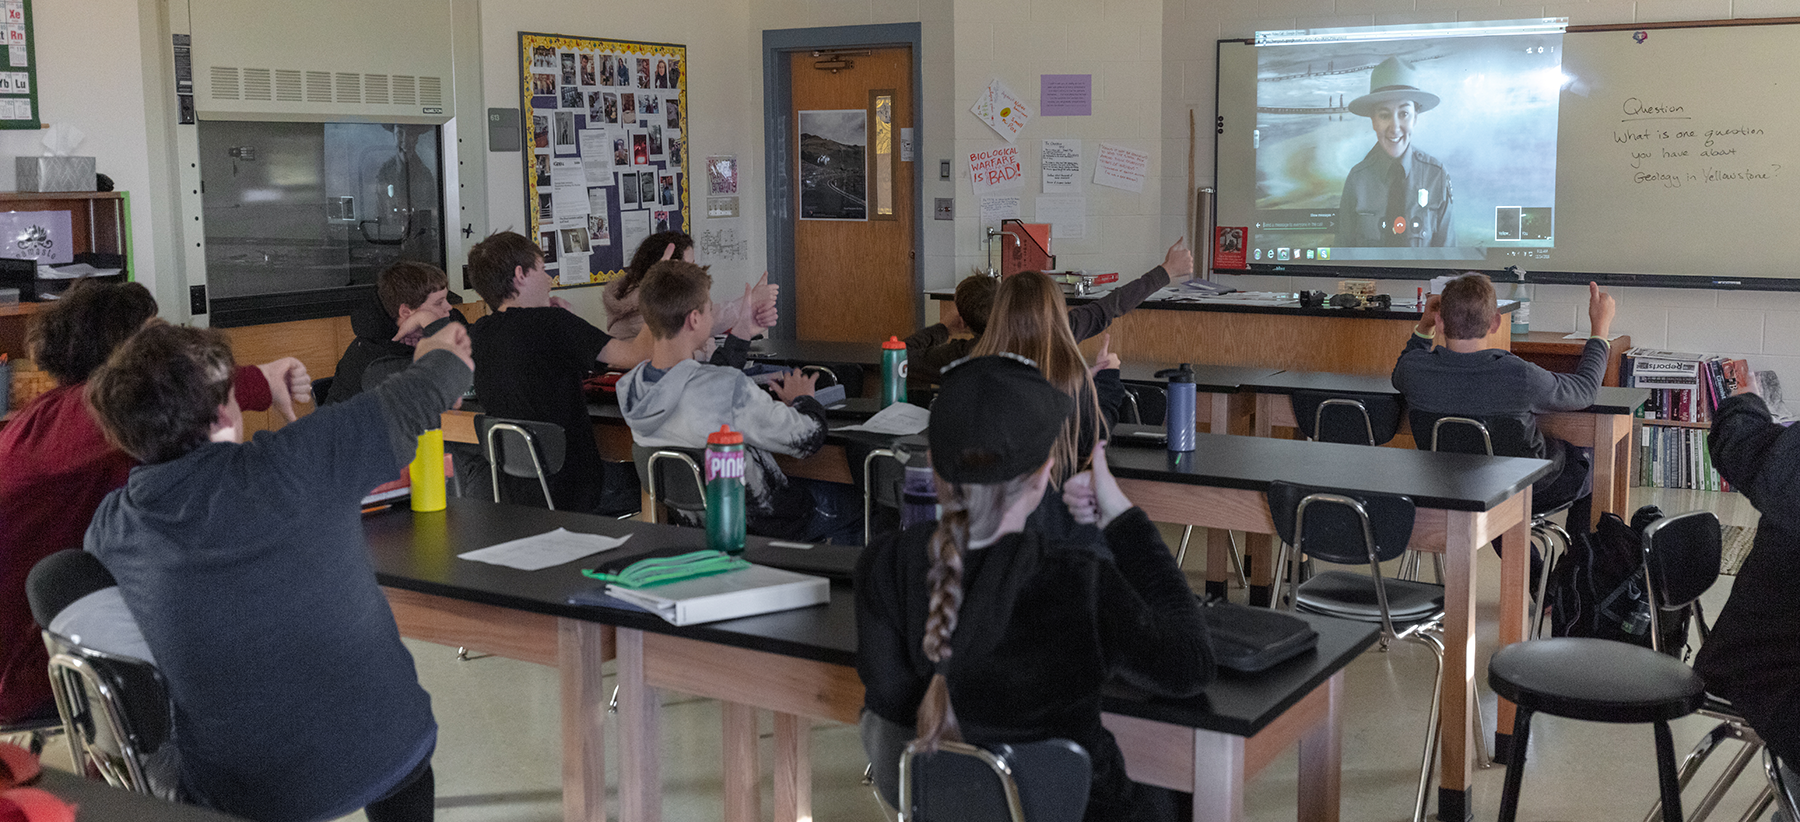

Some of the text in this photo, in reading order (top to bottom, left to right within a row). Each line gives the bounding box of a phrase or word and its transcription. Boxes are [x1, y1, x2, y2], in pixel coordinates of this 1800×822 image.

[9, 9, 21, 19] Xe
[10, 30, 23, 40] Rn
[15, 79, 26, 89] Lu
[1623, 97, 1684, 116] Question
[1613, 125, 1764, 147] What is one question
[970, 147, 1019, 162] BIOLOGICAL
[1630, 147, 1737, 169] you have about
[970, 155, 1016, 172] WARFARE
[974, 172, 984, 183] IS
[1633, 171, 1682, 189] Geology
[1686, 172, 1697, 181] in
[1648, 362, 1683, 370] Reports
[711, 457, 745, 478] PINK
